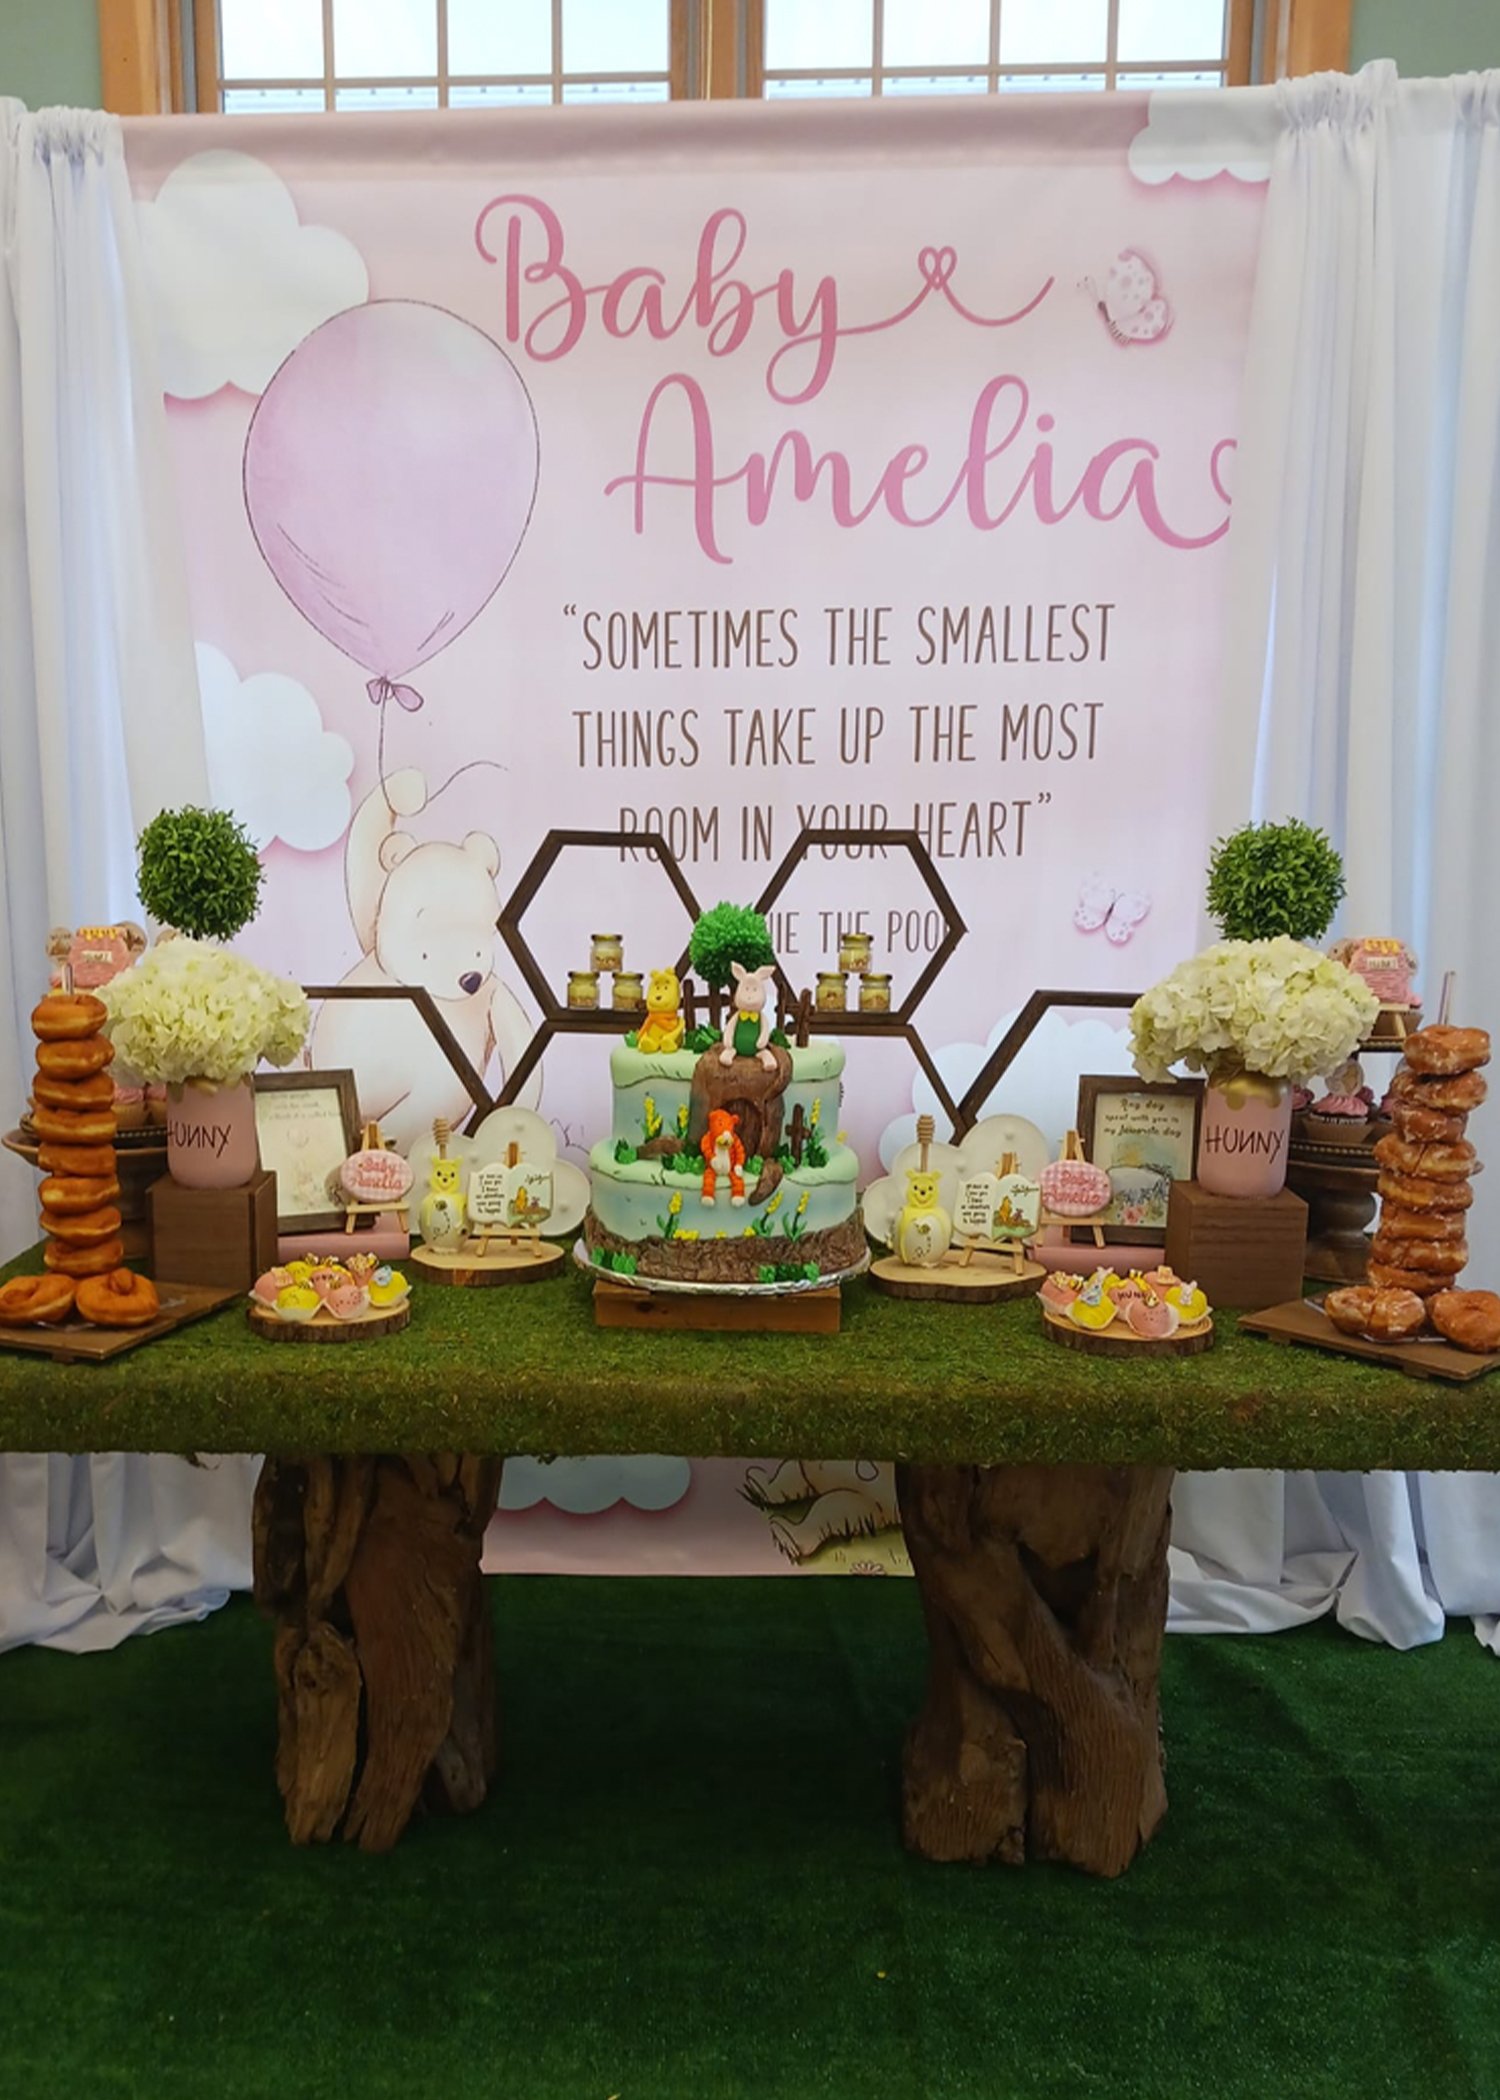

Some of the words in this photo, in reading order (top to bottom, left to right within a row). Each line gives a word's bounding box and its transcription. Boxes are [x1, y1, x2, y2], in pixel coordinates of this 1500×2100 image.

[474, 194, 1055, 404] Baby
[604, 374, 1232, 565] Amelia
[562, 603, 799, 670] “SOMETIMES
[823, 606, 893, 667] THE
[915, 603, 1116, 666] SMALLEST
[571, 708, 700, 768] THINGS
[723, 707, 817, 767] TAKE
[839, 706, 884, 765] UP
[908, 704, 978, 764] THE
[1000, 702, 1104, 762] MOST
[619, 806, 720, 863] ROOM
[741, 804, 773, 862] IN
[796, 803, 889, 860] YOUR
[912, 791, 1053, 859] HEART”
[887, 909, 950, 954] POO
